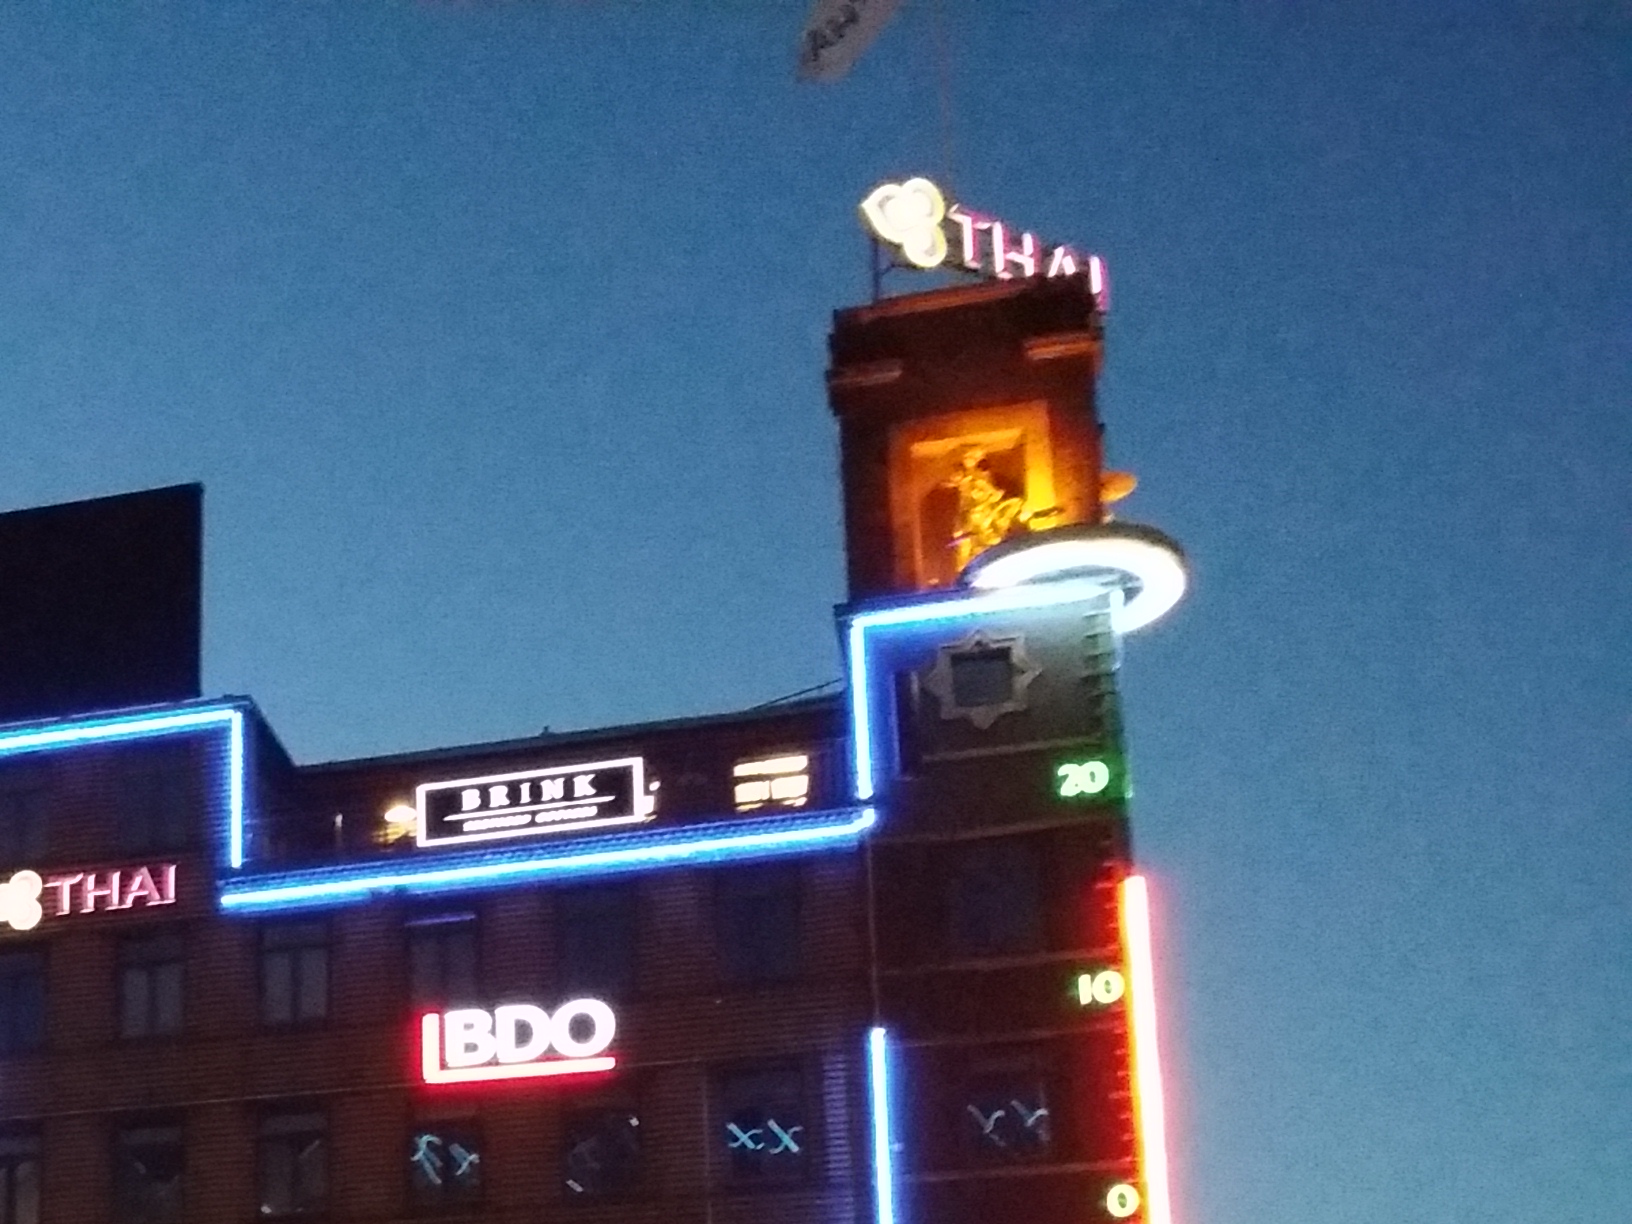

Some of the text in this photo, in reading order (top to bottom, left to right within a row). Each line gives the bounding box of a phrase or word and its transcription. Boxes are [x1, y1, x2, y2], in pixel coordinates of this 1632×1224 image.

[946, 203, 1110, 313] THAI
[460, 774, 597, 812] BRINK
[1056, 760, 1110, 798] 20
[43, 864, 178, 917] THAI
[1077, 970, 1125, 1005] 10
[443, 998, 617, 1068] BDO
[1105, 1182, 1140, 1217] 0
